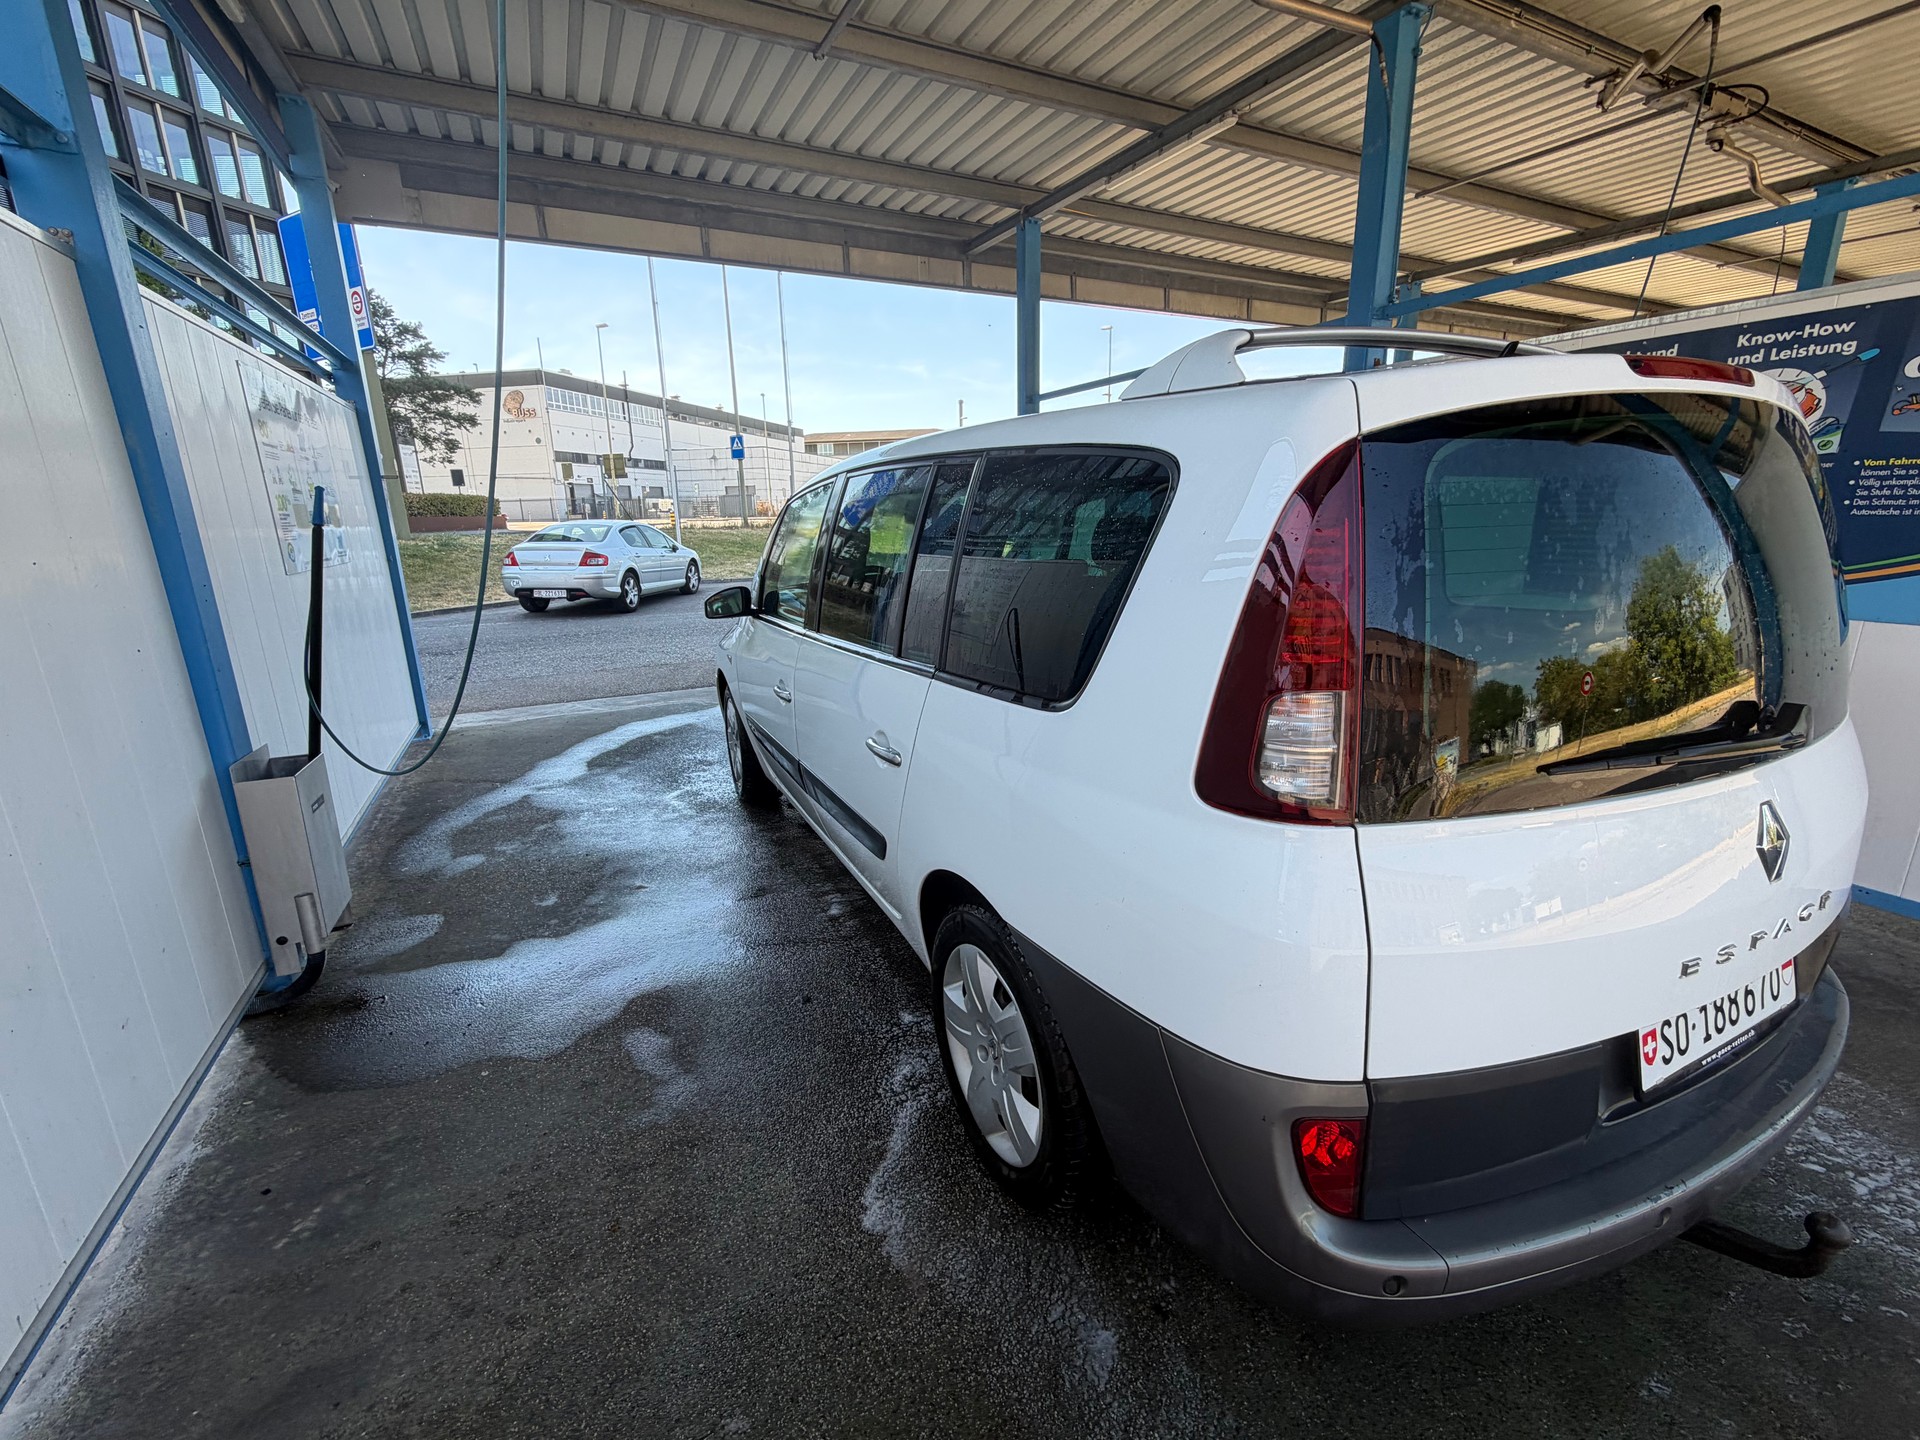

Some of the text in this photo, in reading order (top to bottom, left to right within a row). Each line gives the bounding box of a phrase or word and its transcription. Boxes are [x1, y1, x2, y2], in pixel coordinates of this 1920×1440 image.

[1737, 320, 1856, 348] Know-How
[1727, 339, 1858, 366] und Leistung
[512, 408, 537, 418] BUSS
[1863, 459, 1886, 467] Vom
[1860, 468, 1891, 476] können
[1892, 467, 1906, 475] Sie
[1858, 478, 1881, 488] Völlig
[1855, 488, 1869, 496] Sie
[1870, 487, 1891, 496] Stufe
[1893, 487, 1905, 496] für
[1853, 498, 1870, 506] Den
[1871, 497, 1907, 506] Schmutz
[1850, 507, 1900, 516] Autowäsche
[1679, 890, 1832, 979] ESPACE
